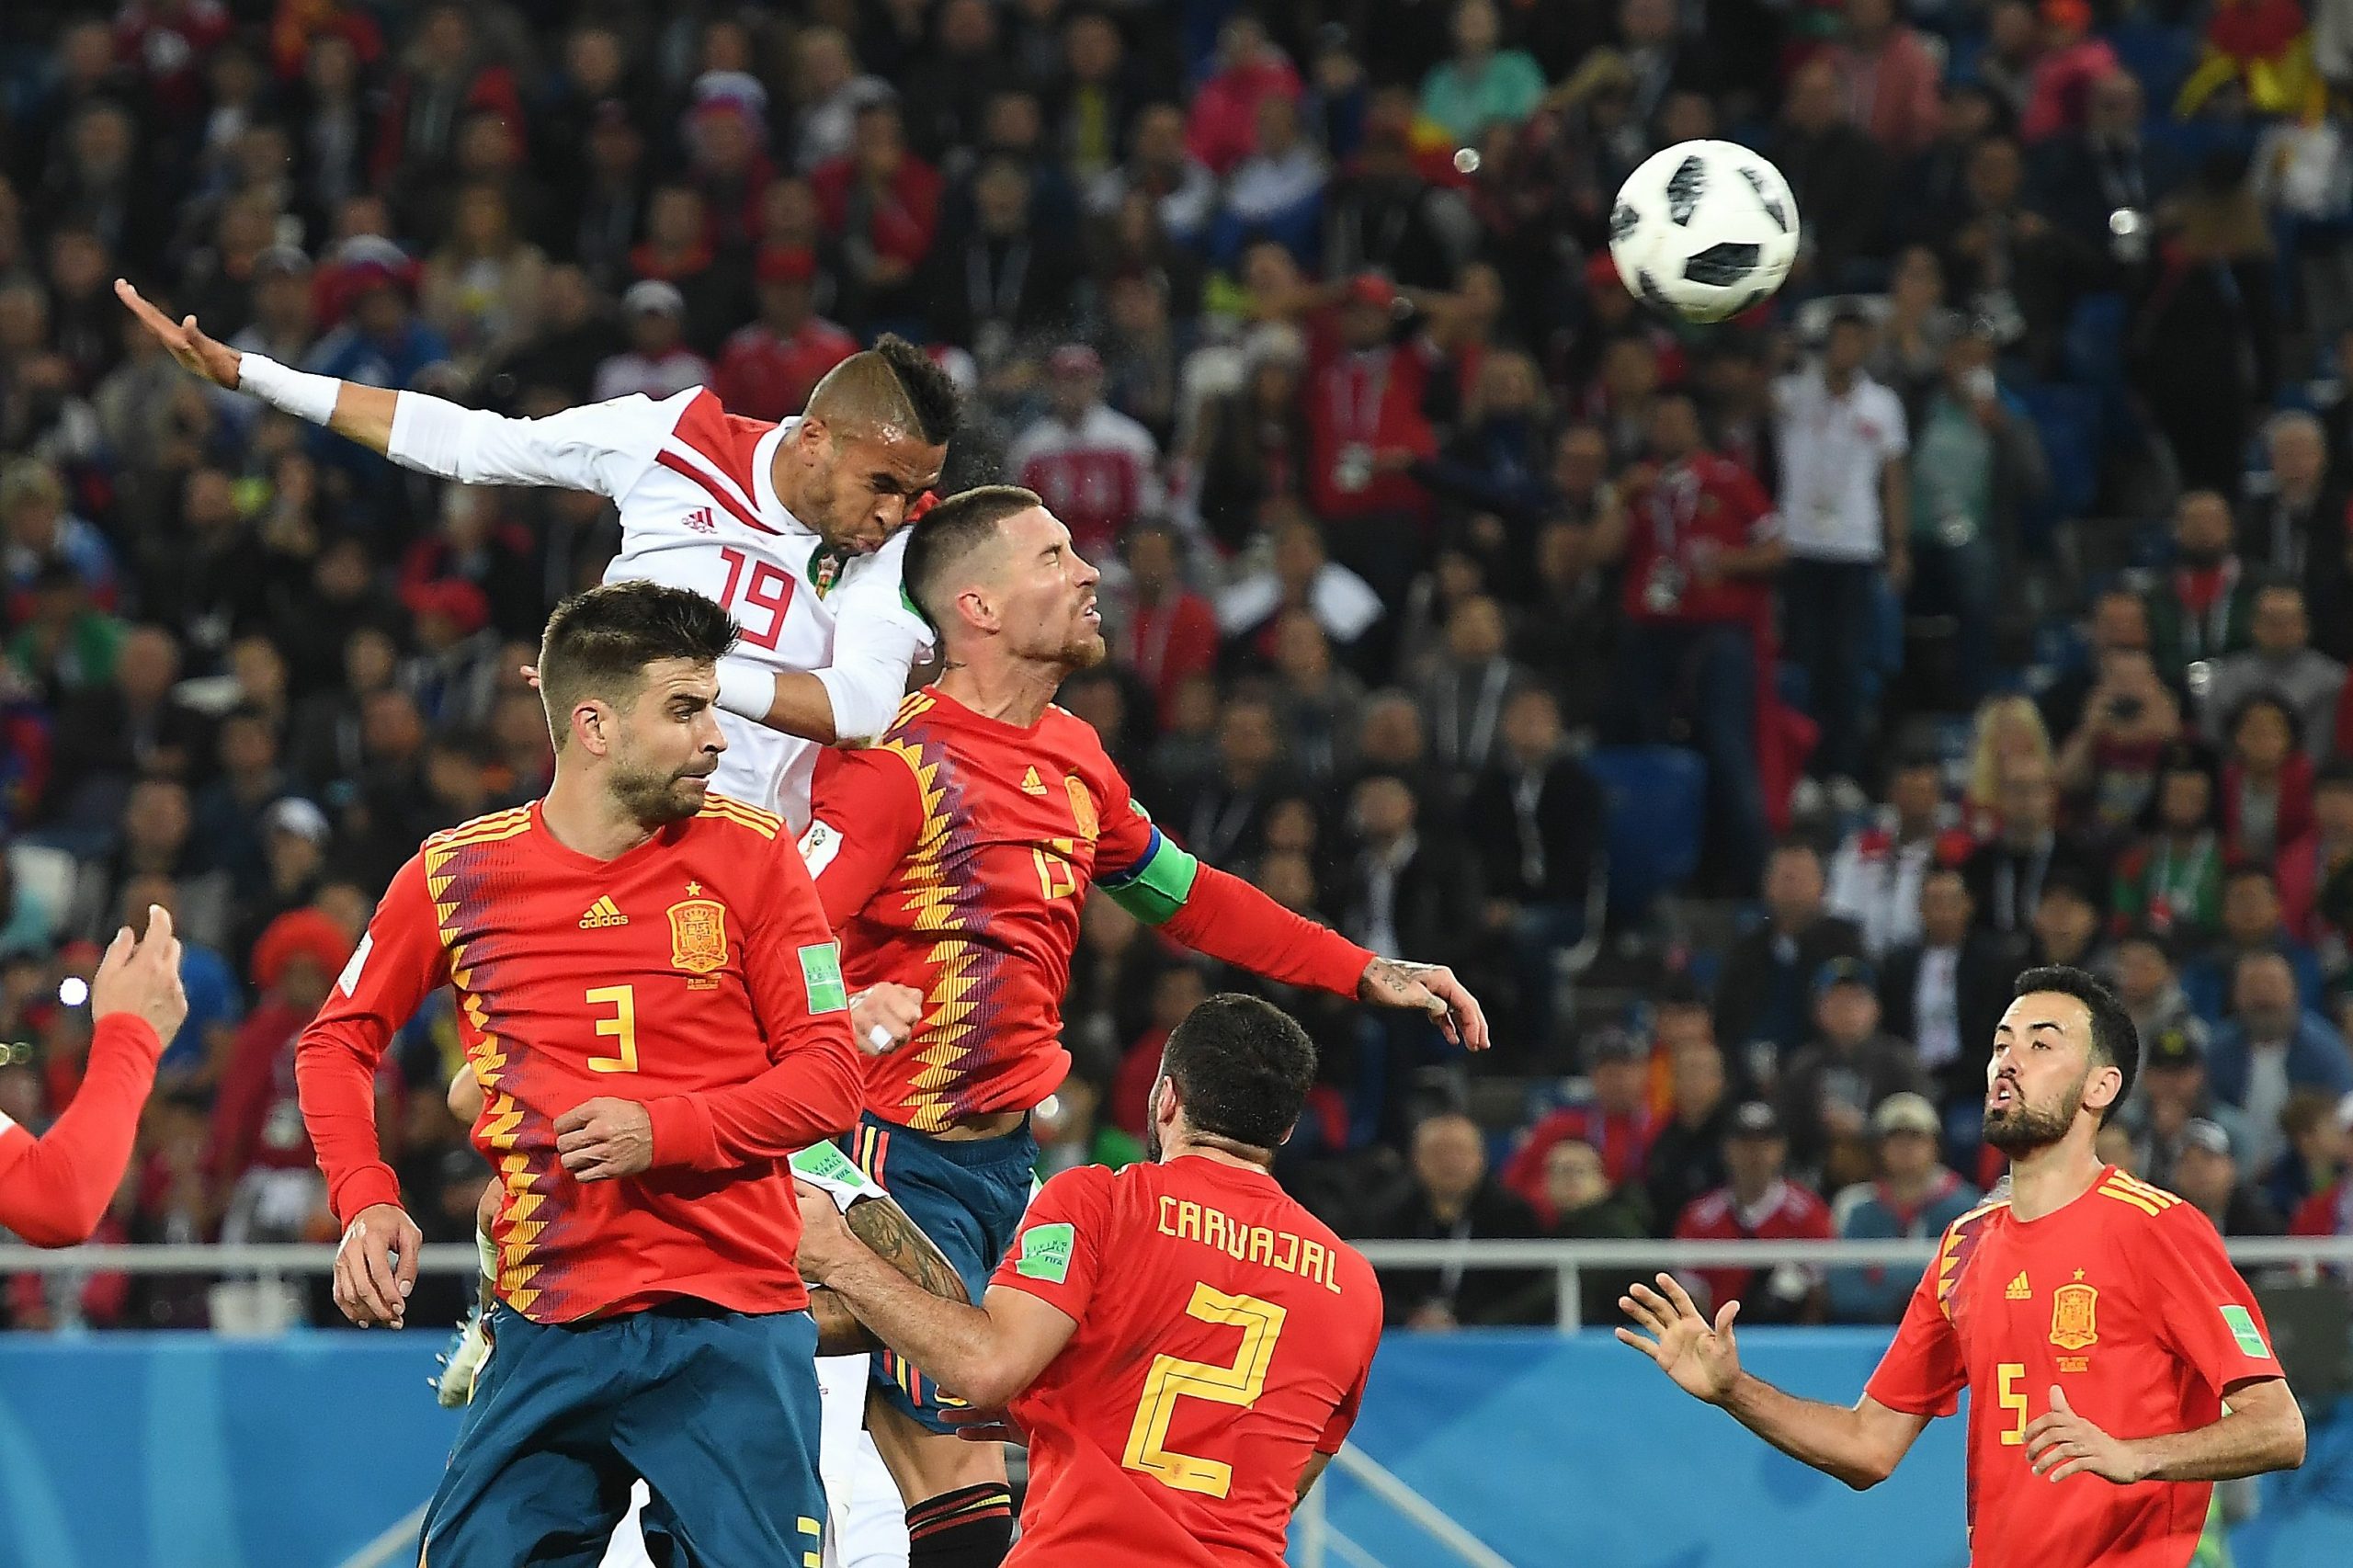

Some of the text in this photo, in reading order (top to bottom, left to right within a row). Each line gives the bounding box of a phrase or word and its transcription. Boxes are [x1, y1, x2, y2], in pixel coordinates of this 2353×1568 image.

[721, 545, 797, 651] 19
[1032, 838, 1076, 901] 15
[578, 914, 629, 929] adidas
[585, 984, 639, 1073] 3
[813, 1153, 837, 1171] VING
[1157, 1195, 1343, 1295] CARVAJAL
[1121, 1280, 1288, 1500] 2
[1997, 1363, 2028, 1446] 5
